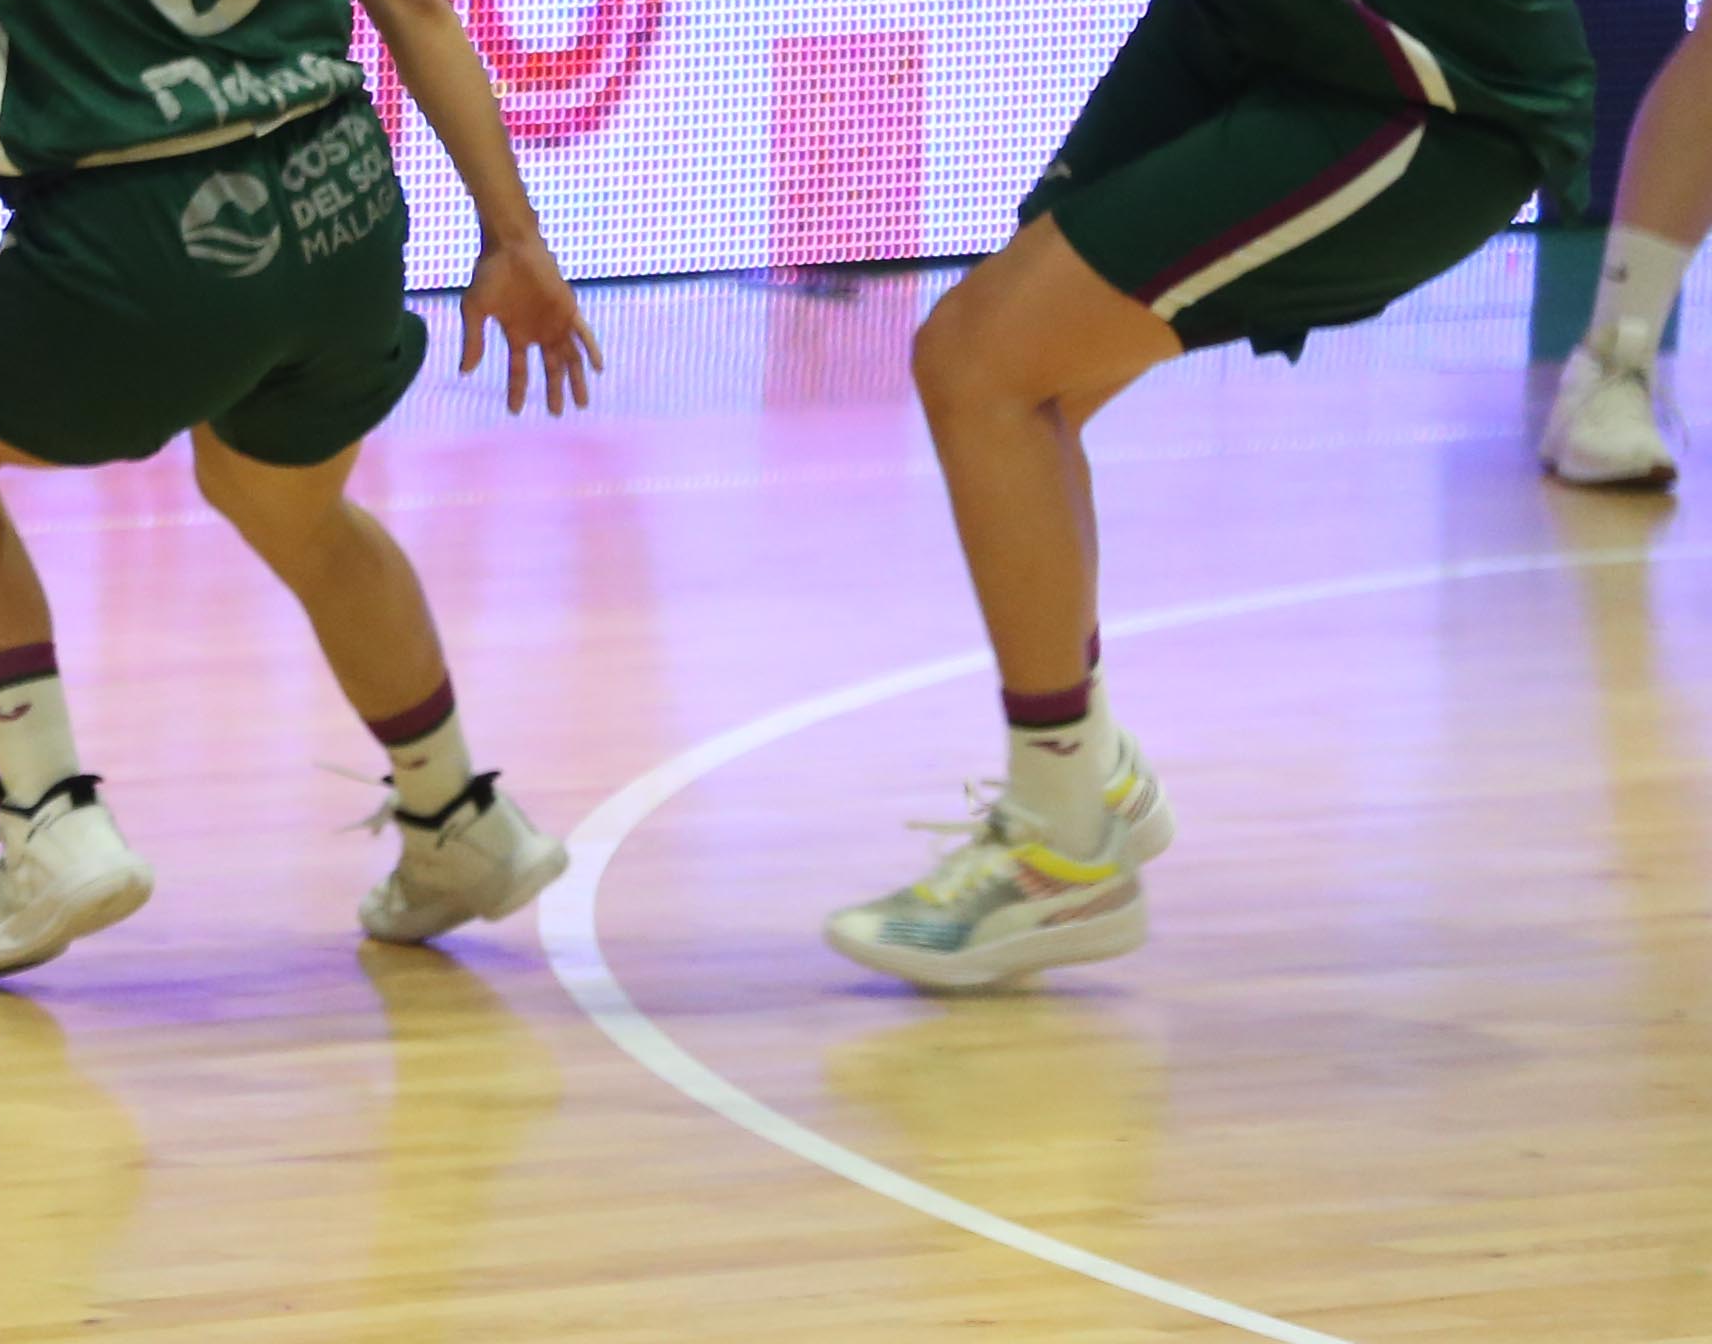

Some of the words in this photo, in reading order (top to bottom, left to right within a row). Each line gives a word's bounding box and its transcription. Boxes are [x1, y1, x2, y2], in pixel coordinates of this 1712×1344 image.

[282, 115, 373, 192] COSTA
[291, 180, 355, 230] DEL
[301, 186, 397, 264] MÁLAG
